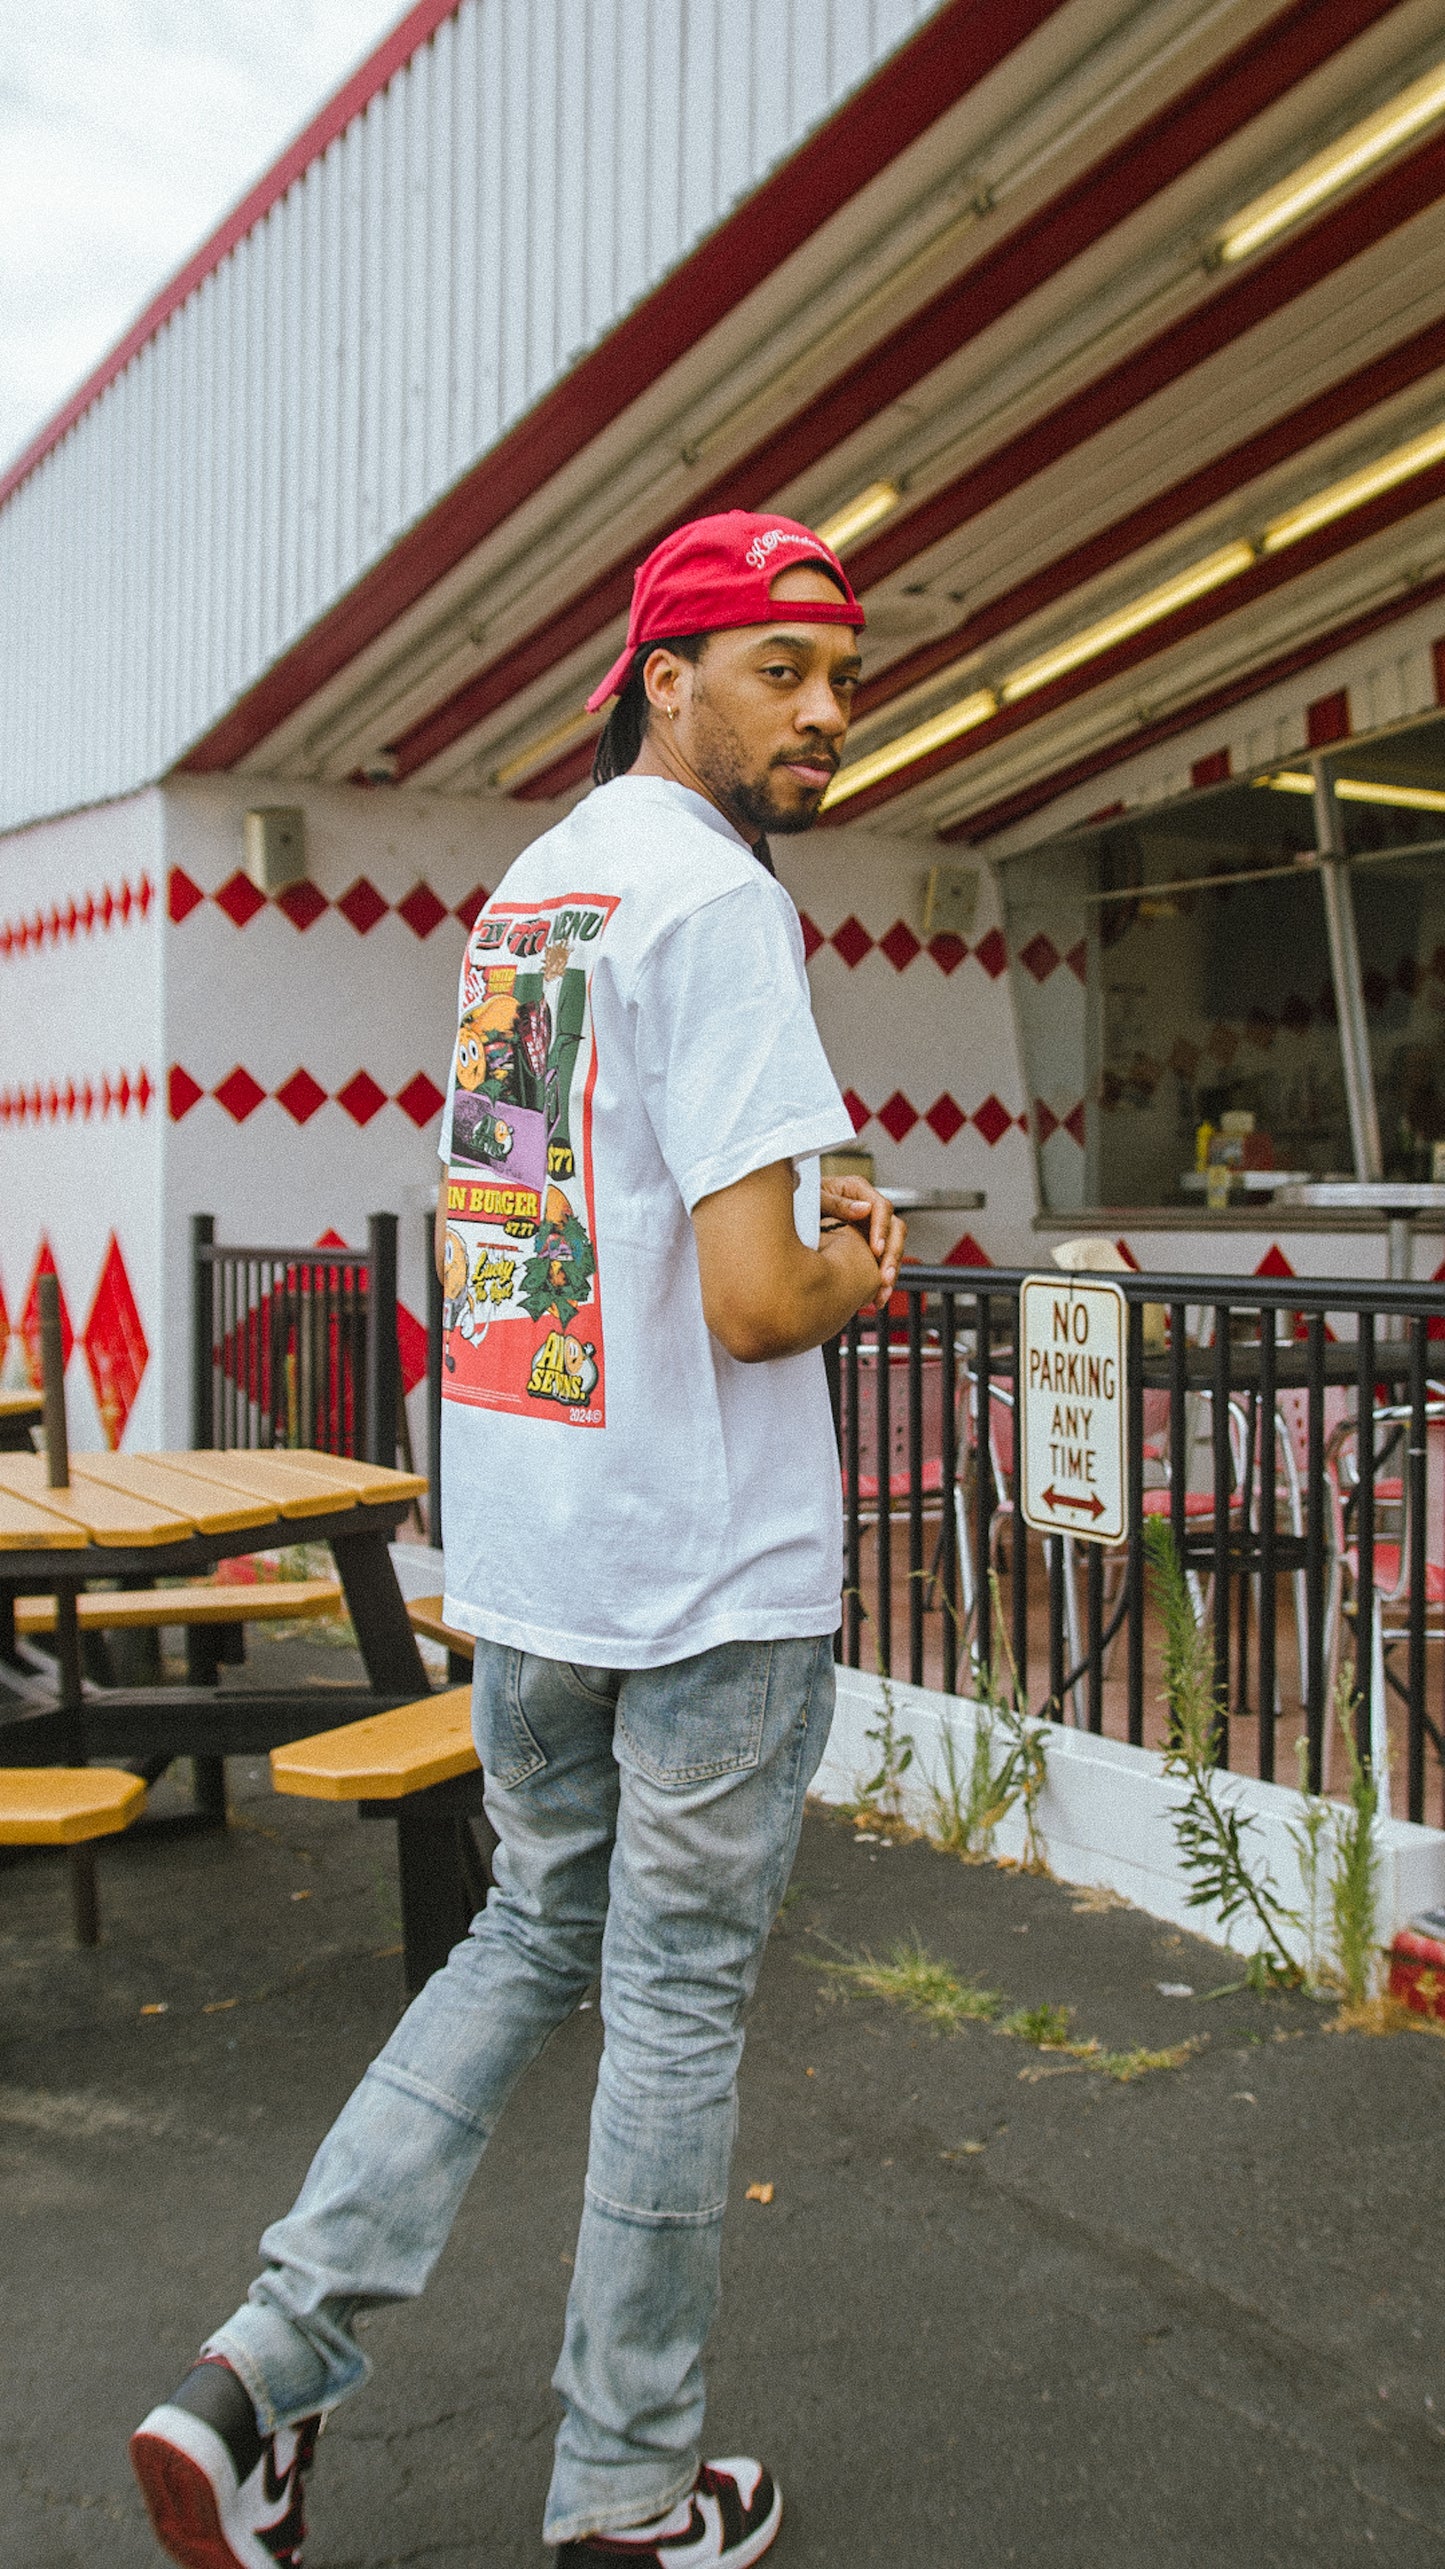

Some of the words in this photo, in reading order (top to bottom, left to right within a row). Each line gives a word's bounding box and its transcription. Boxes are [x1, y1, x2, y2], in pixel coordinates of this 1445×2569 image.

[469, 1188, 537, 1218] BURGER
[1053, 1301, 1089, 1344] NO
[1030, 1349, 1115, 1400] PARKING
[1051, 1404, 1093, 1440] ANY
[1050, 1444, 1097, 1483] TIME
